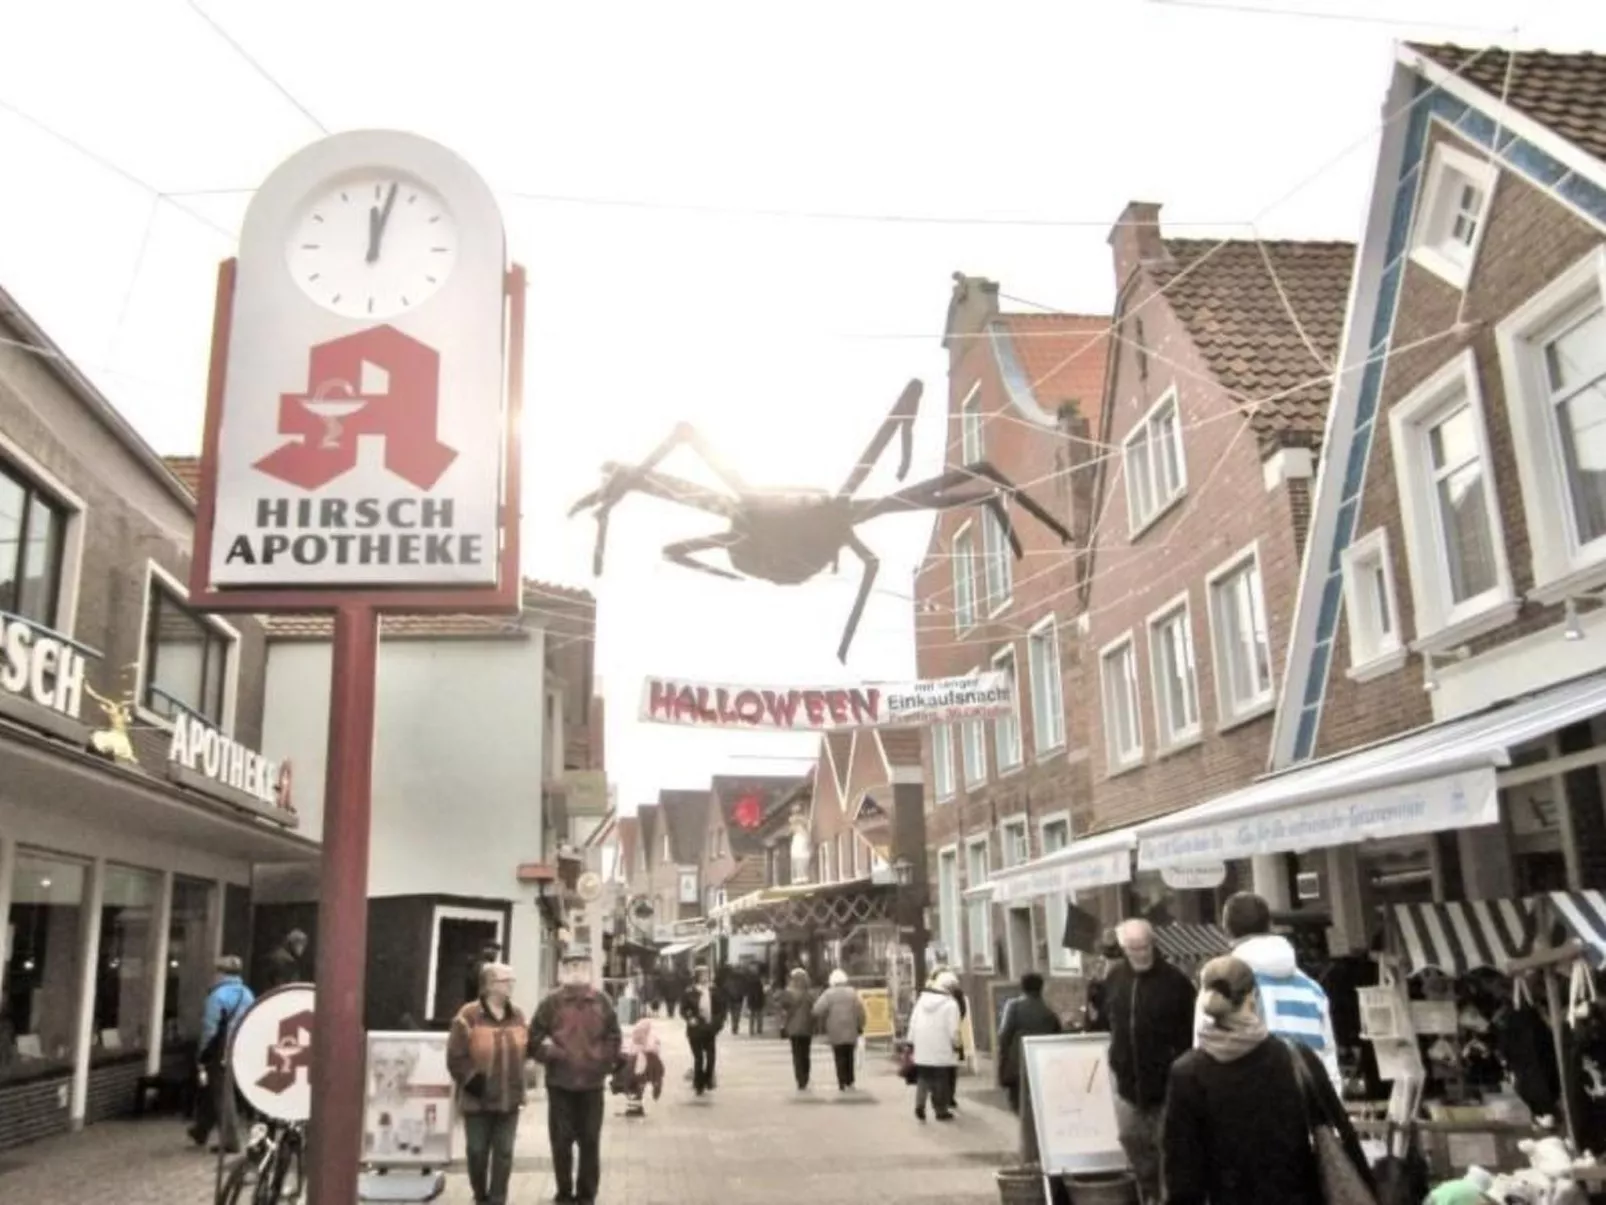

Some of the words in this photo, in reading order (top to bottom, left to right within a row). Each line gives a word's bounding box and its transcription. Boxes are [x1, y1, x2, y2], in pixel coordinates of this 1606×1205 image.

[256, 498, 454, 528] HIRSCH
[225, 534, 482, 564] APOTHEKE
[0, 613, 85, 718] SCH
[168, 712, 277, 805] APOTHEKE
[649, 680, 881, 727] HALLOWEEN
